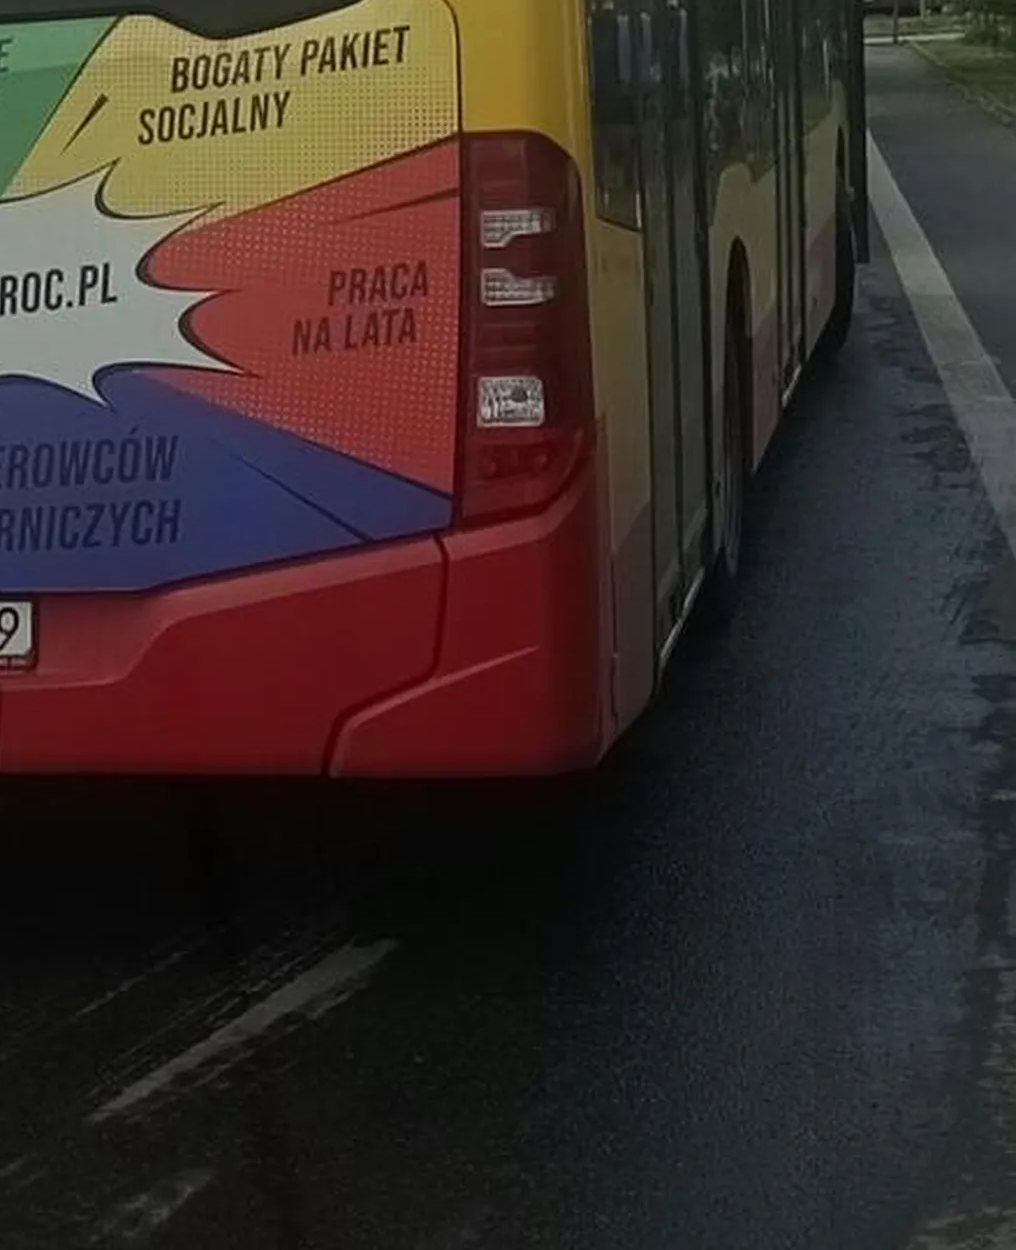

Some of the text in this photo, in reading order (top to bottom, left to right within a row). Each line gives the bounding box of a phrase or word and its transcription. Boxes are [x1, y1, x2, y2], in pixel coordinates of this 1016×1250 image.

[171, 25, 411, 93] BOGATY PAKIET
[138, 91, 291, 145] SOCJALNY
[328, 260, 428, 307] PRACA
[292, 307, 417, 357] NA LATA
